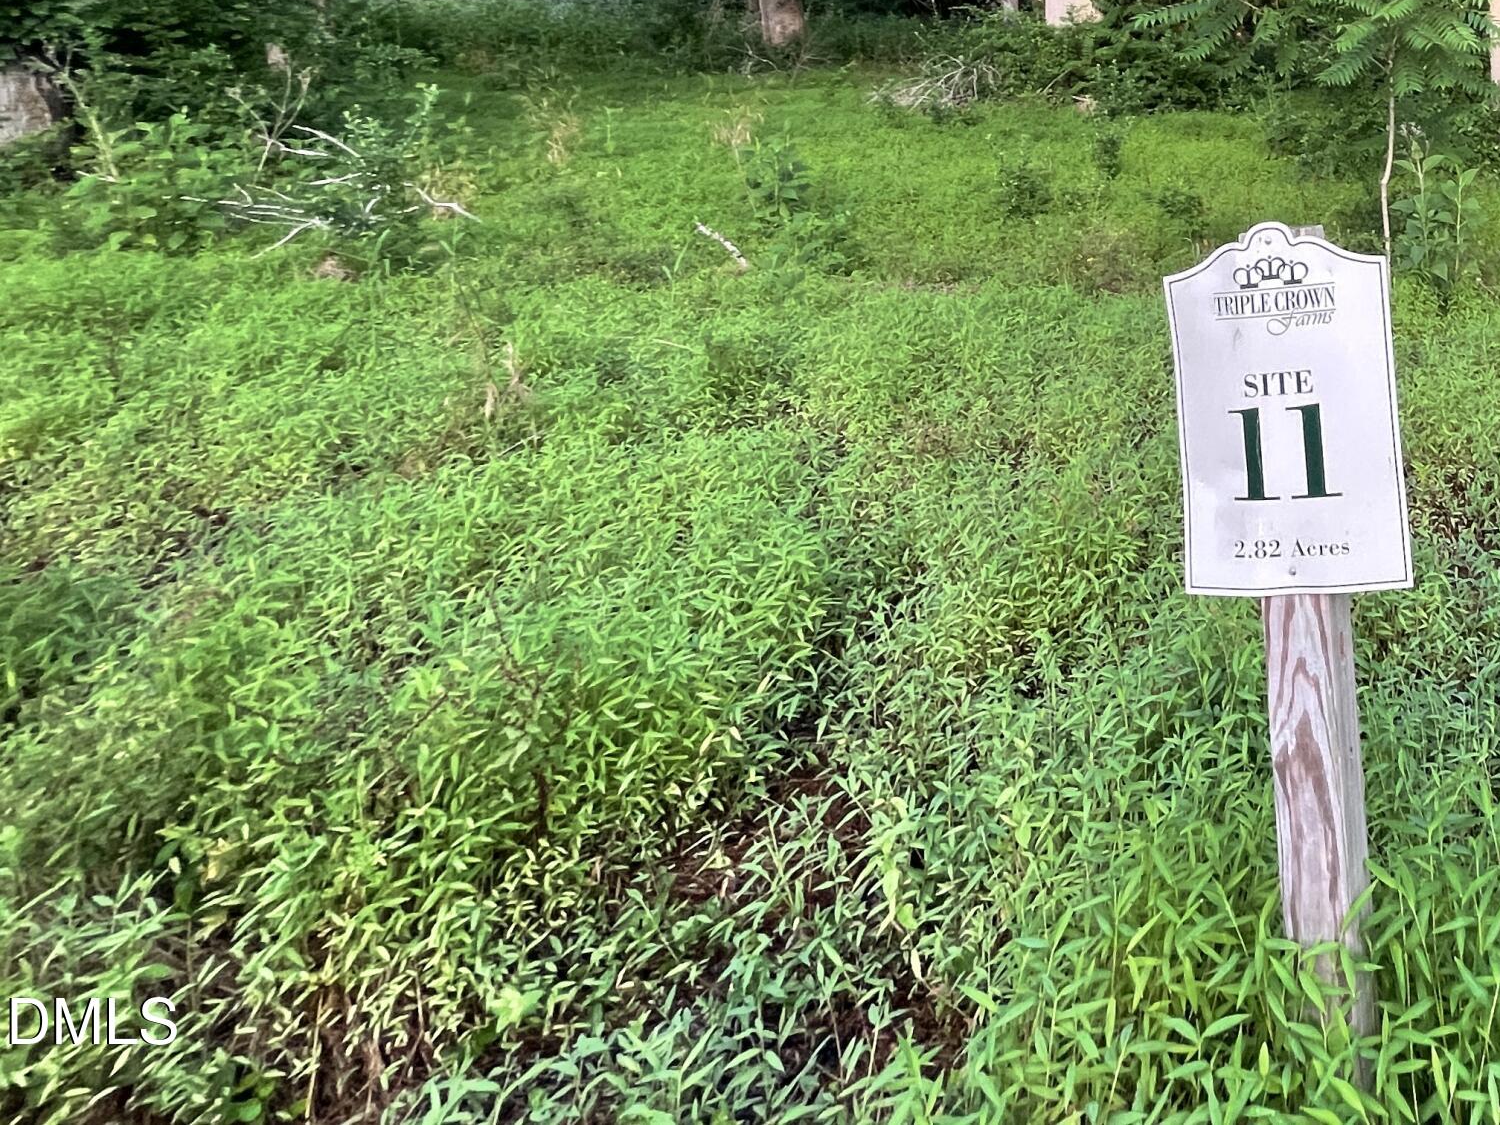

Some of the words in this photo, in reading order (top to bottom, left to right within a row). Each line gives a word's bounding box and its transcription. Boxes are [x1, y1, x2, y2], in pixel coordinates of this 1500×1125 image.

[1214, 291, 1272, 317] TRIPLE
[1274, 286, 1336, 312] CROWN
[1266, 309, 1335, 336] Farms
[1243, 370, 1314, 398] SITE
[1228, 403, 1343, 501] 11
[1234, 540, 1282, 559] 2.82
[1291, 536, 1350, 558] Acres
